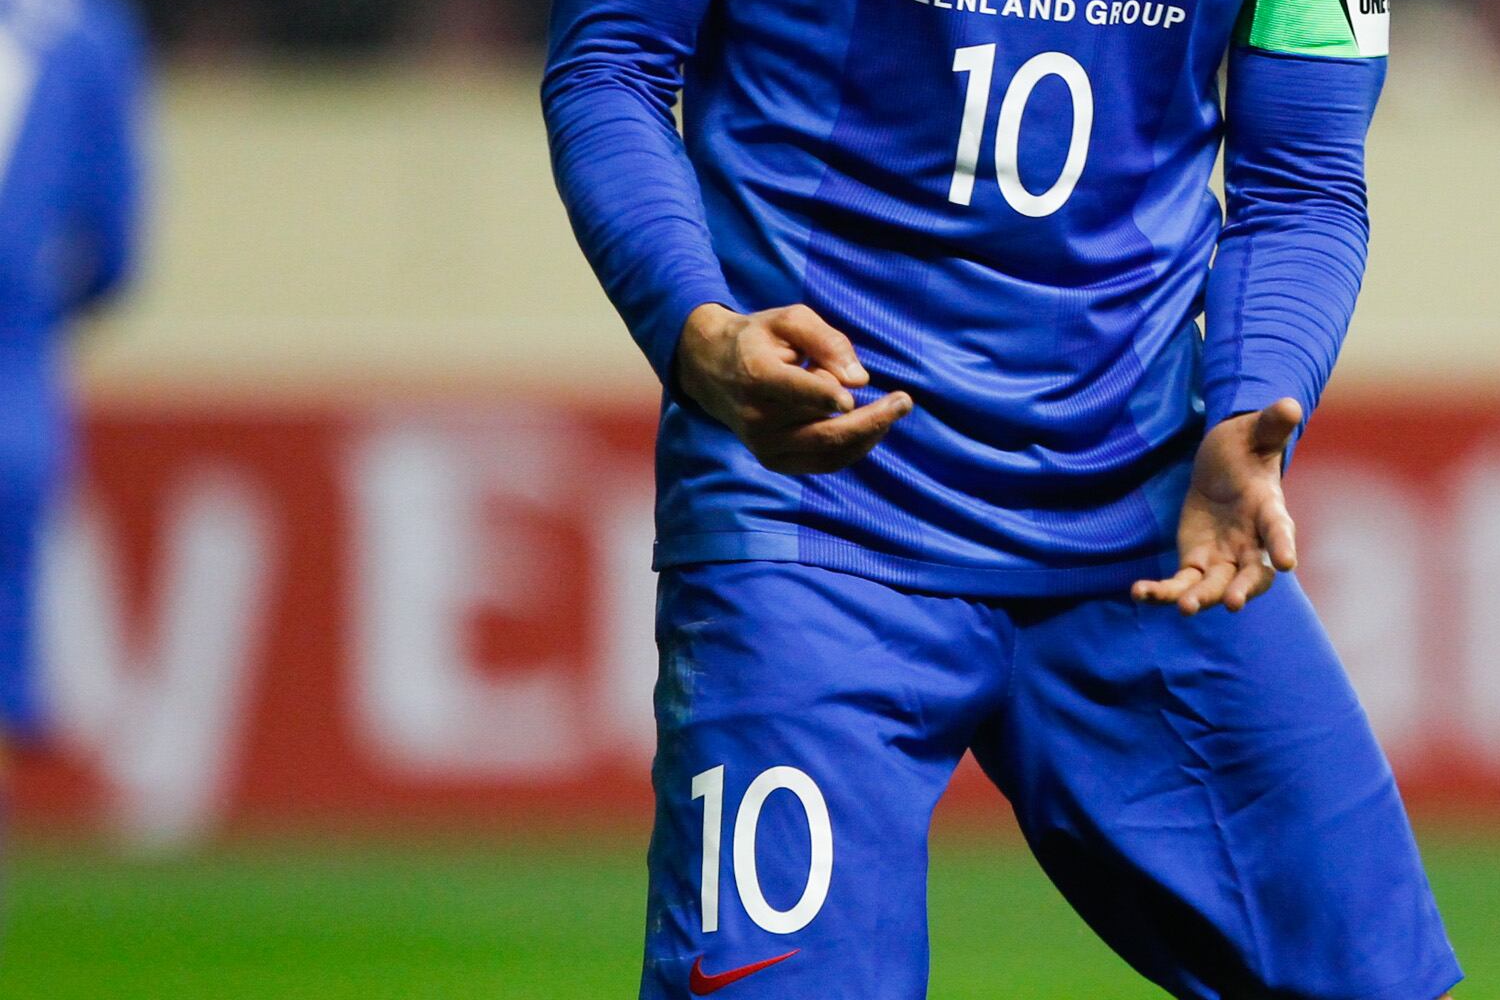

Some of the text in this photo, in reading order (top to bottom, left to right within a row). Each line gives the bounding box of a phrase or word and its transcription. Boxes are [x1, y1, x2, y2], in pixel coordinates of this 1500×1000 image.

[1085, 0, 1187, 30] GROUP
[948, 42, 1094, 218] 10
[691, 764, 835, 935] 10
